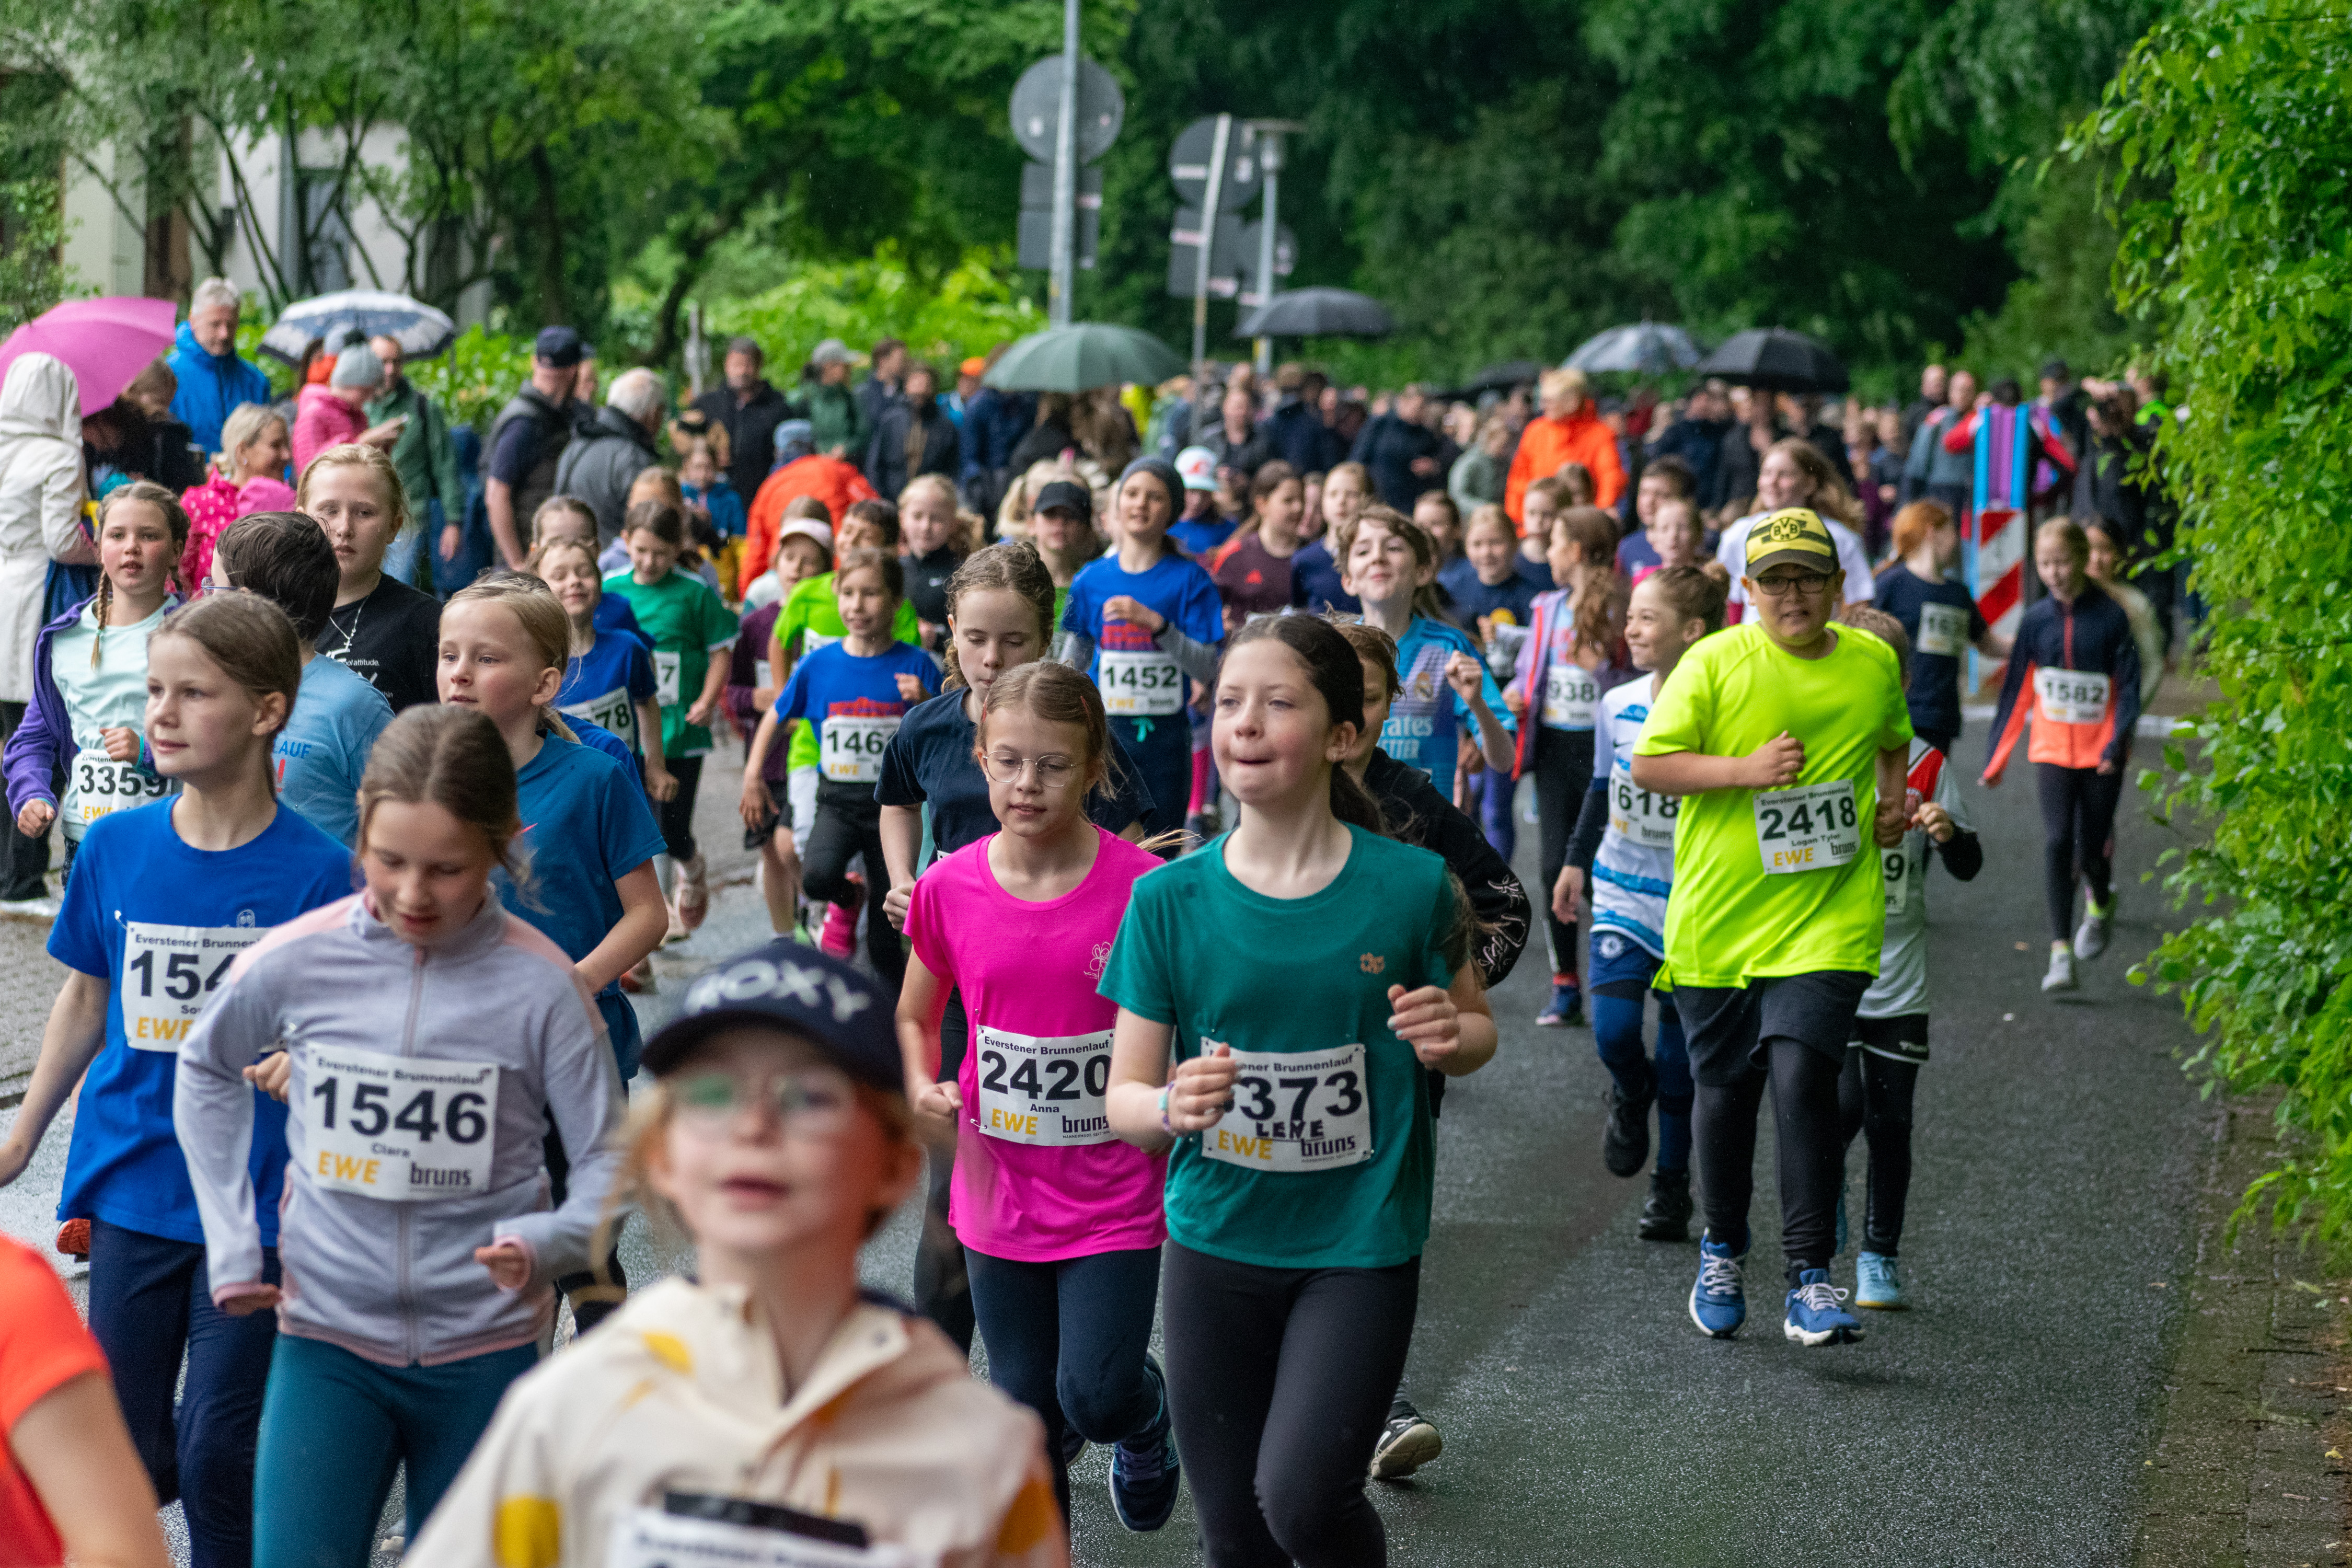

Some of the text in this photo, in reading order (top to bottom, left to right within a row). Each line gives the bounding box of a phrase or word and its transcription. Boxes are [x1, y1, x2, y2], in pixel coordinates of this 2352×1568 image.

[1773, 517, 1797, 536] BVB
[1104, 665, 1178, 689] 1452
[2046, 681, 2104, 704] 1582
[583, 704, 630, 728] 78
[274, 741, 312, 758] AUF
[827, 730, 894, 755] 146
[80, 764, 168, 798] 3359
[1611, 778, 1679, 819] 1618
[1759, 796, 1855, 841] 2418
[1773, 841, 1855, 867] EWE bruns
[1791, 838, 1818, 846] Logan
[136, 933, 199, 948] Everstener
[985, 1036, 1110, 1055] Everstener Brunnenlauf
[317, 1056, 492, 1085] Everstener Brunnenlauf
[1274, 1054, 1353, 1071] Brunnenlauf
[981, 1050, 1112, 1101] 2420
[1030, 1103, 1060, 1113] Anna
[1224, 1070, 1362, 1121] 373
[313, 1076, 488, 1145] 1546
[991, 1108, 1109, 1135] EWE bruns
[371, 1142, 411, 1158] Clara
[1218, 1130, 1273, 1160] EWE
[1301, 1135, 1355, 1157] bruns
[317, 1150, 471, 1186] EWE bruns
